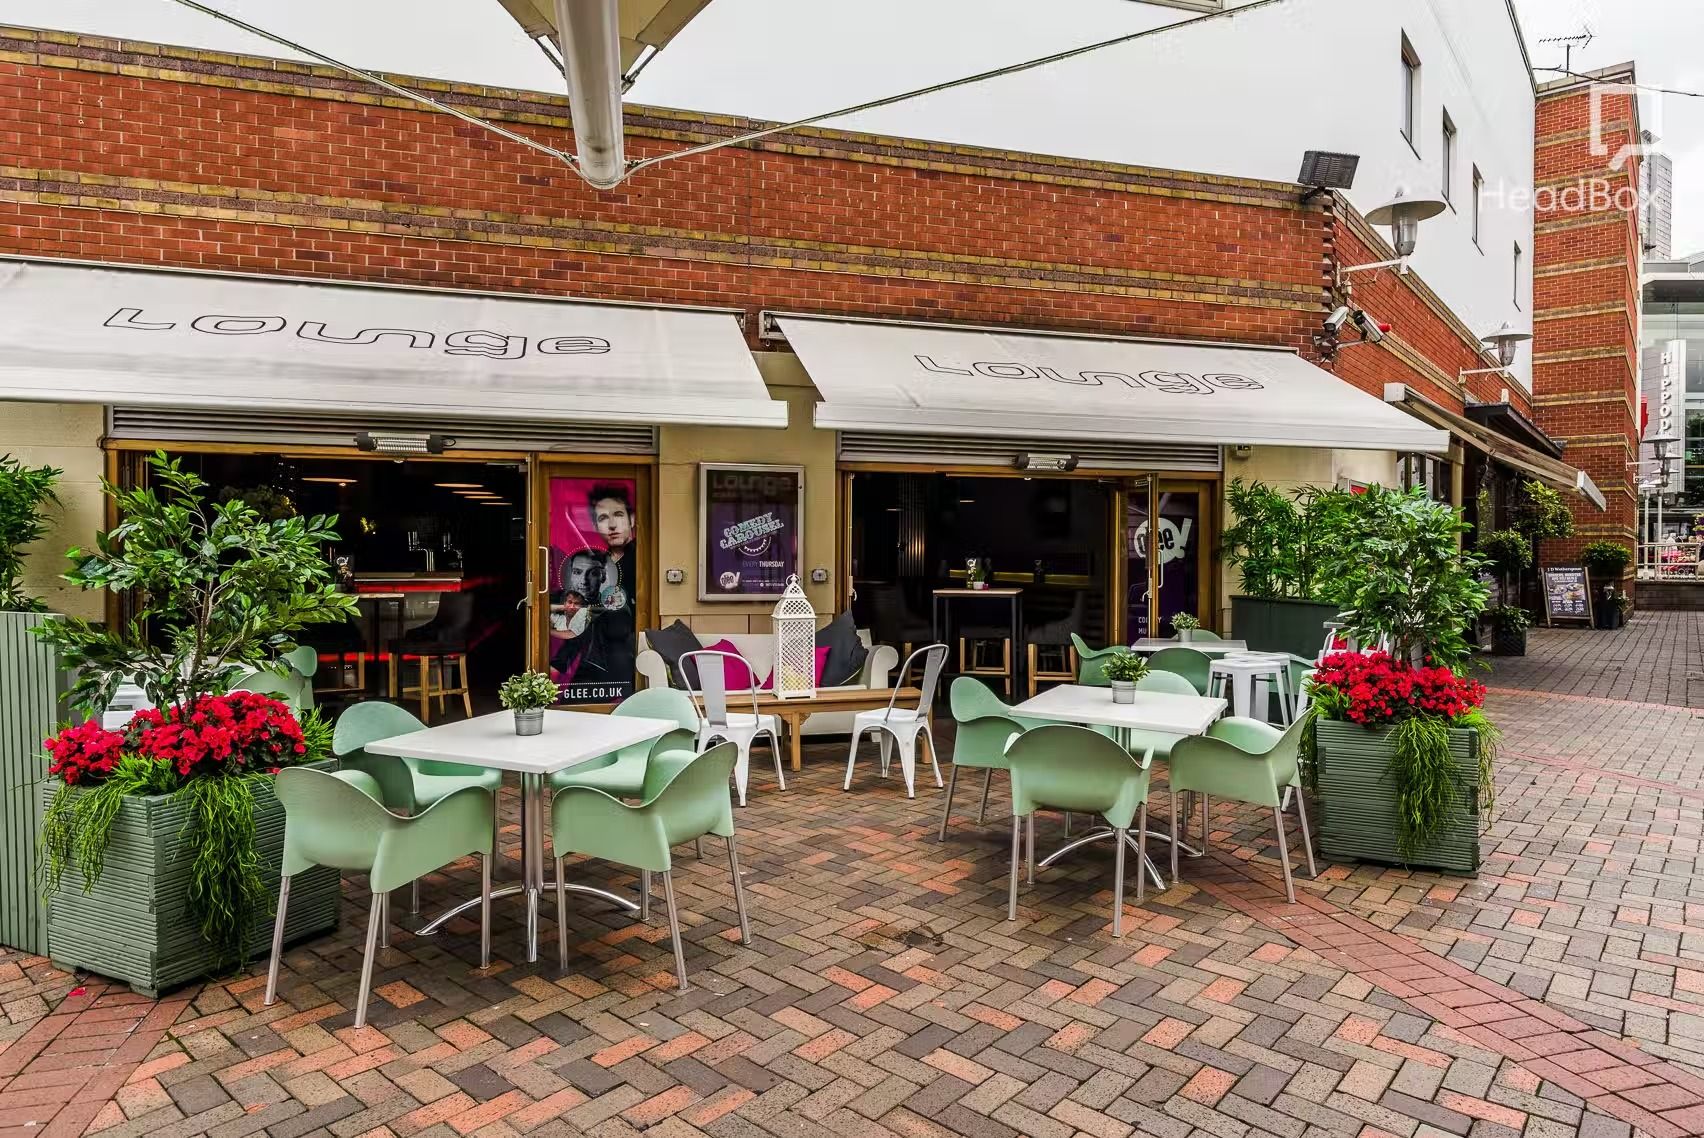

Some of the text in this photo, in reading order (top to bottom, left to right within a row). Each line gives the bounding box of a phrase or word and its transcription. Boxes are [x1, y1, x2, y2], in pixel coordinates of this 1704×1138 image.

[723, 511, 772, 537] COMEDY
[719, 519, 785, 549] CAROUSEL
[759, 560, 784, 568] THURSDAY
[563, 688, 623, 701] GLEE.CO.UK
